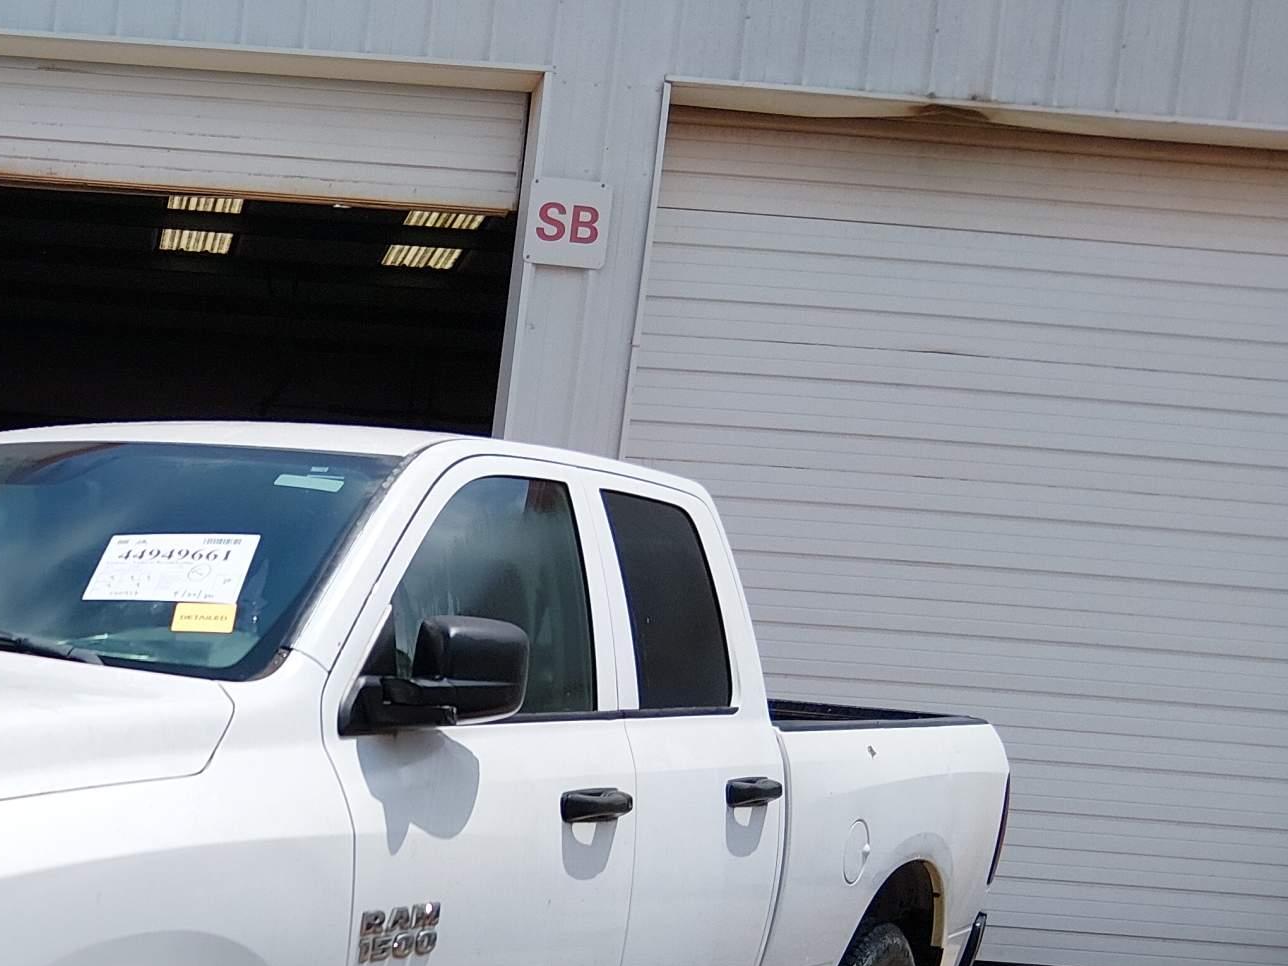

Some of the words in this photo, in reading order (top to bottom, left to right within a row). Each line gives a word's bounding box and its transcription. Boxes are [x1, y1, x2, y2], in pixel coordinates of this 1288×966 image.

[535, 202, 599, 244] SB
[117, 548, 231, 561] 44949661
[359, 902, 441, 937] RAM
[358, 927, 438, 964] 1500
